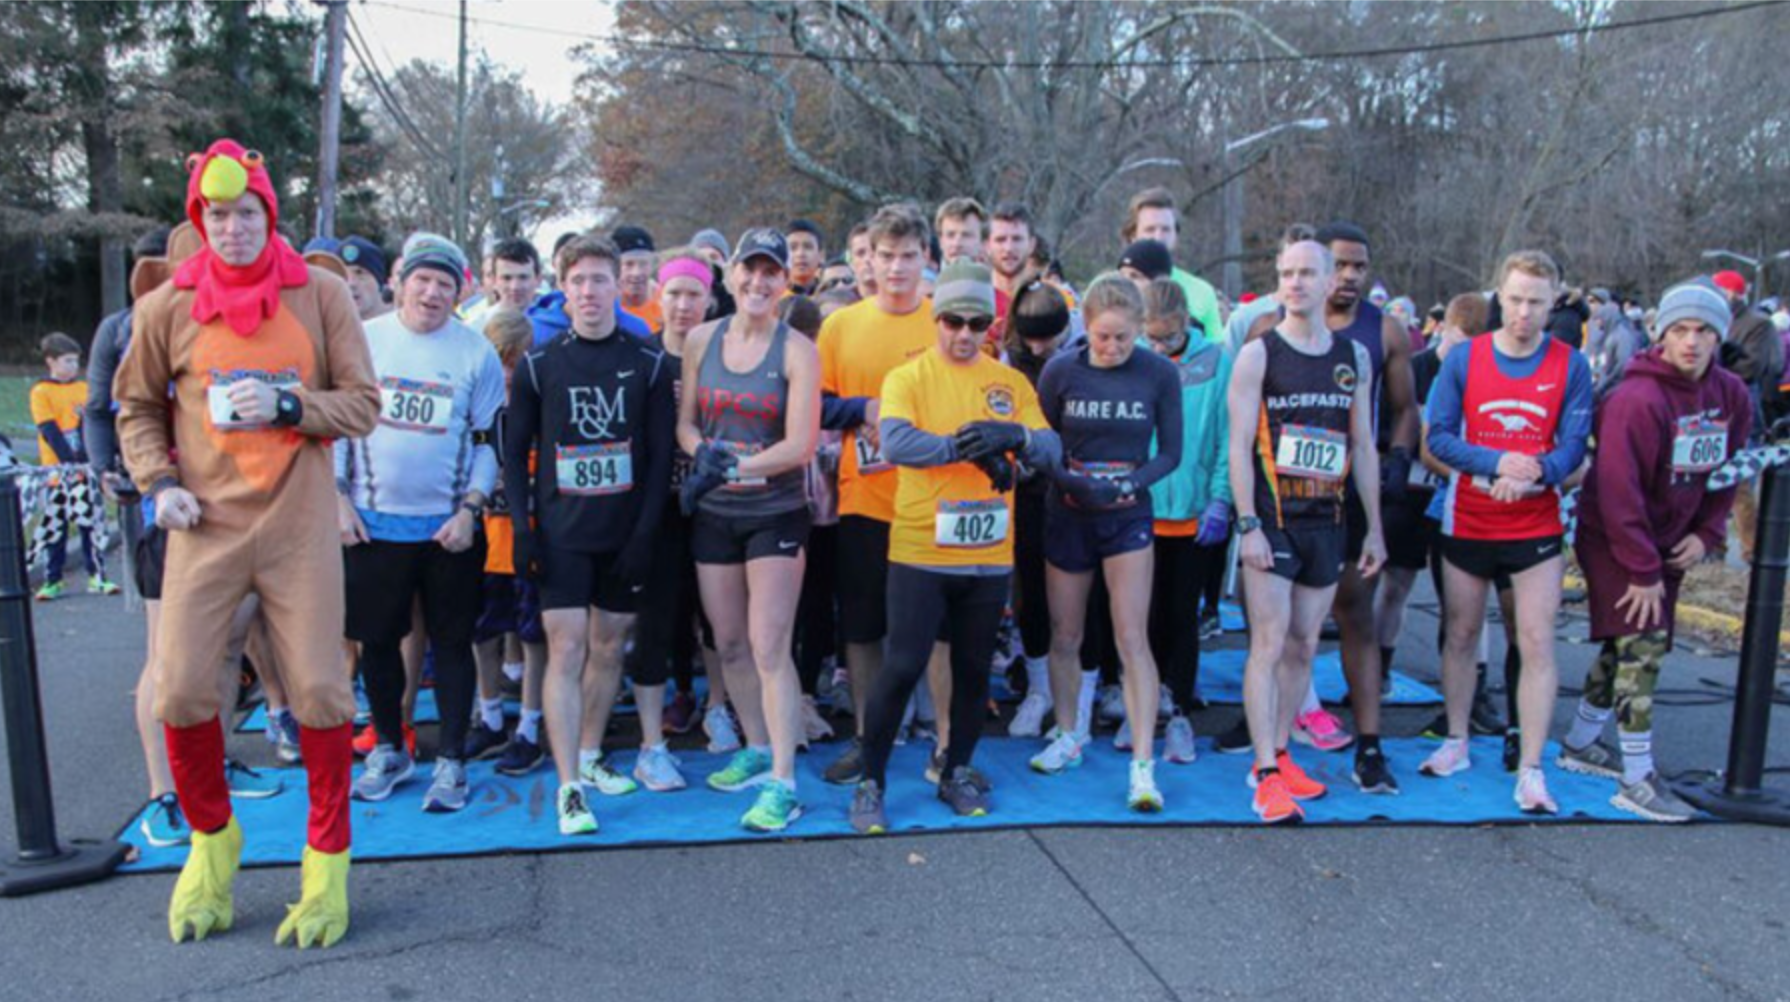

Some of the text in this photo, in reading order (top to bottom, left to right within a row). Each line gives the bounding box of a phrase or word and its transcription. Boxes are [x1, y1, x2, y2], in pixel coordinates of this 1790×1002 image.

[390, 392, 434, 424] 360
[1116, 401, 1147, 419] A.C.
[1292, 440, 1337, 471] 1012
[1690, 437, 1722, 462] 606
[575, 458, 617, 487] 894
[954, 514, 995, 543] 402
